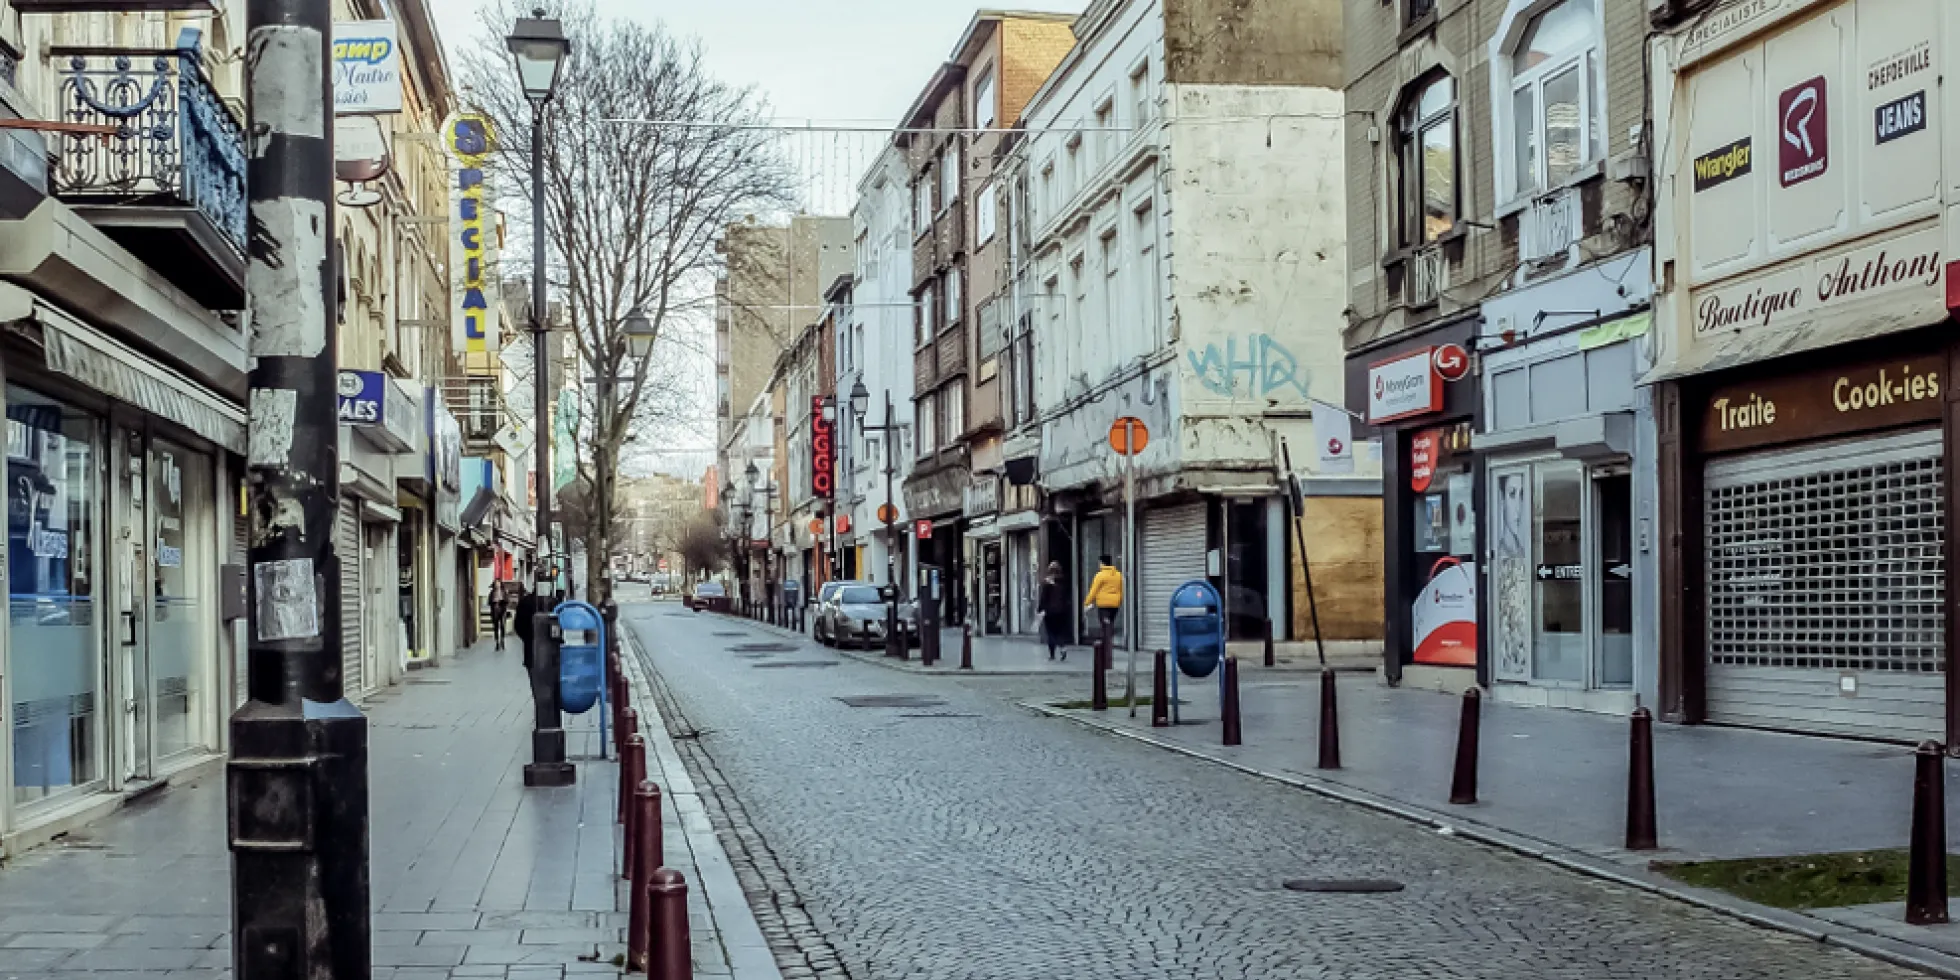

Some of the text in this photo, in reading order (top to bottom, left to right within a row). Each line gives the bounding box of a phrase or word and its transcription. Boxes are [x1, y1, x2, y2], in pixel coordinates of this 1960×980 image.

[1878, 96, 1922, 138] JEANS
[1695, 144, 1751, 180] Wrangler
[455, 118, 487, 339] SPECIAL
[1697, 250, 1941, 333] Boutique Anthony
[1832, 364, 1940, 412] Cook-ies
